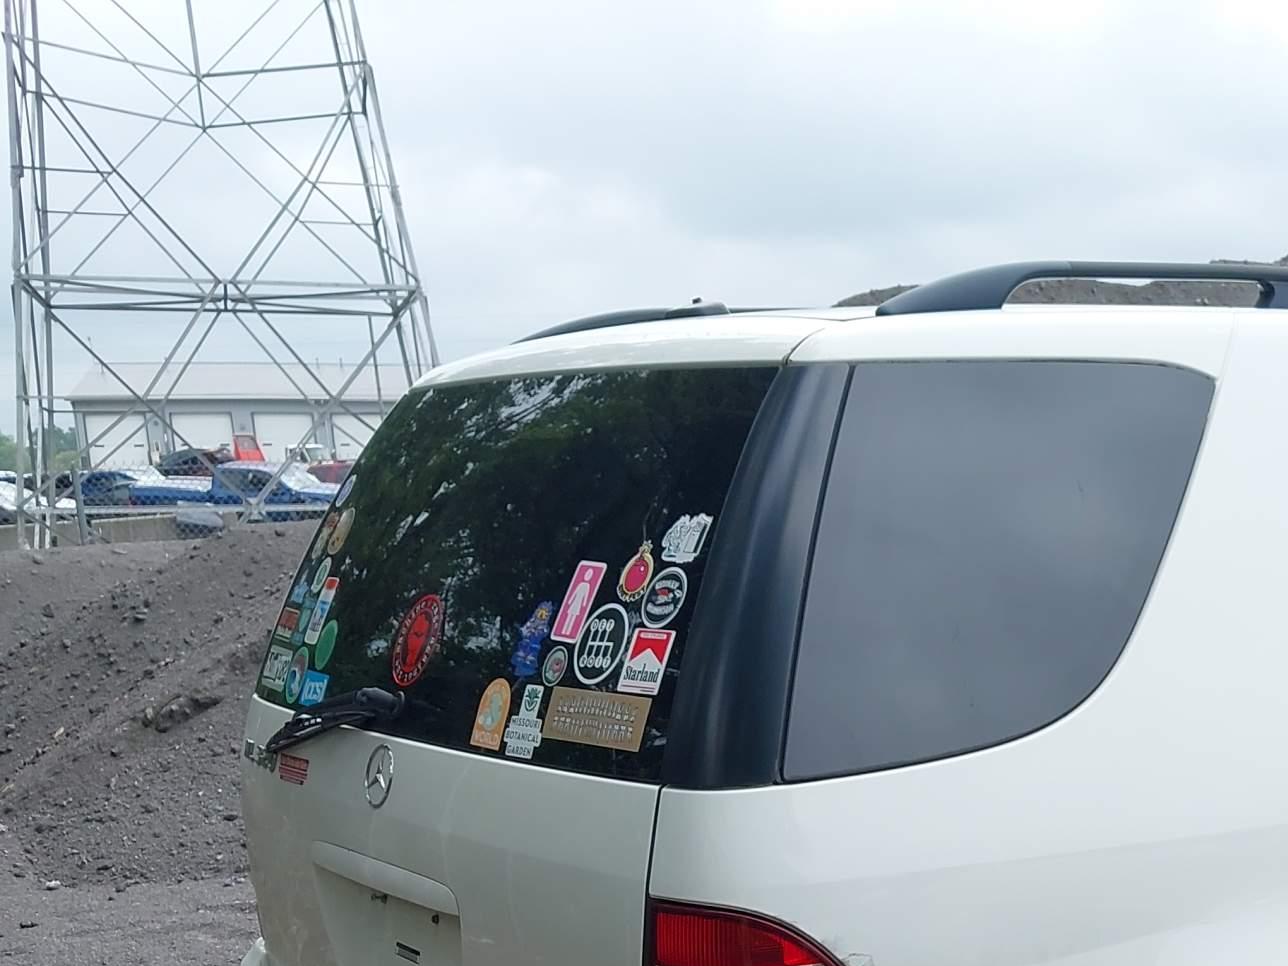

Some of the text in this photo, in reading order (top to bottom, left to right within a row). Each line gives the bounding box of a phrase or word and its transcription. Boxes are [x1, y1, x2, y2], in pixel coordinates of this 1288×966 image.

[623, 664, 660, 683] Starland
[511, 717, 541, 729] MISSOURI
[505, 730, 539, 744] BOTANICAL
[506, 744, 532, 757] GARDEN
